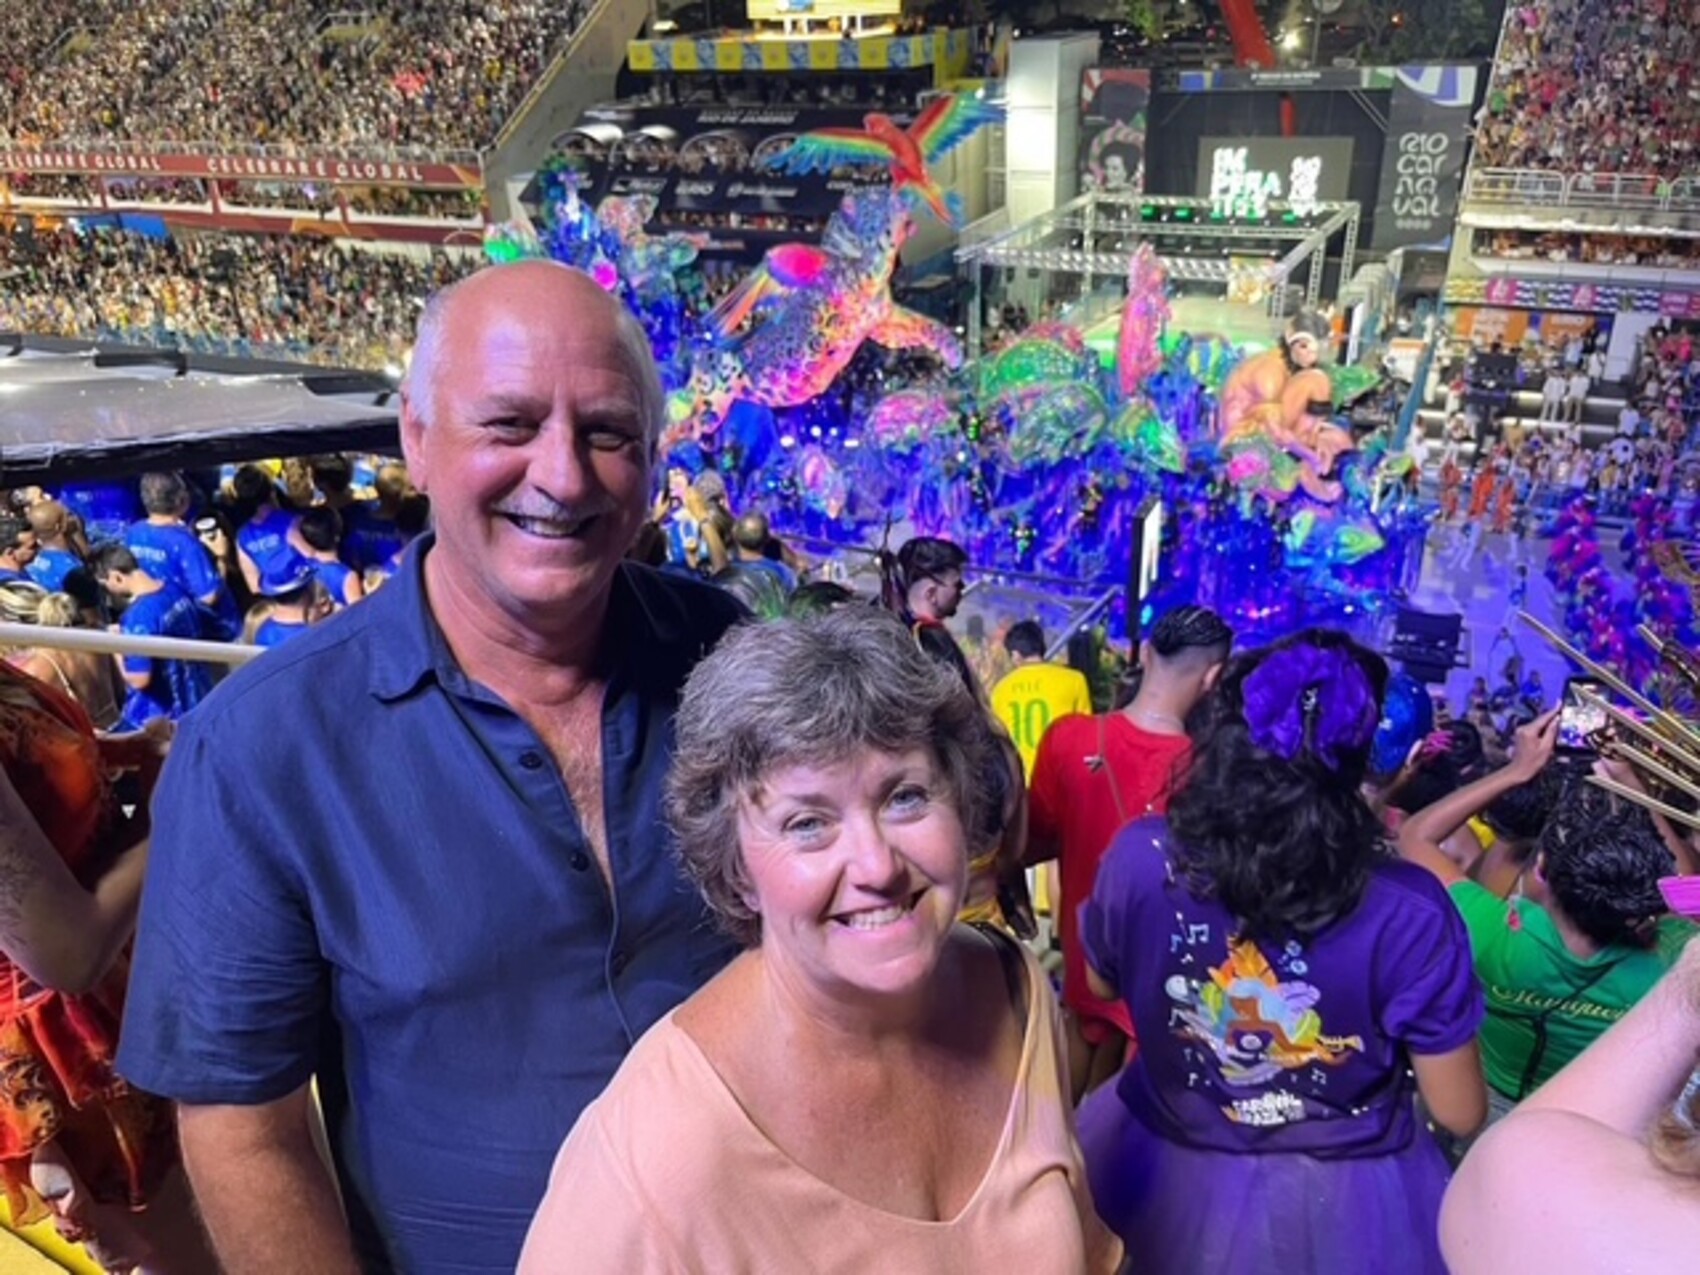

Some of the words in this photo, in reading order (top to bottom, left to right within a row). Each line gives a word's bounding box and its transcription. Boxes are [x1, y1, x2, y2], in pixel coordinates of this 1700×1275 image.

[95, 153, 161, 171] GLOBAL
[336, 162, 423, 180] GLOBAL
[1008, 698, 1050, 749] 10
